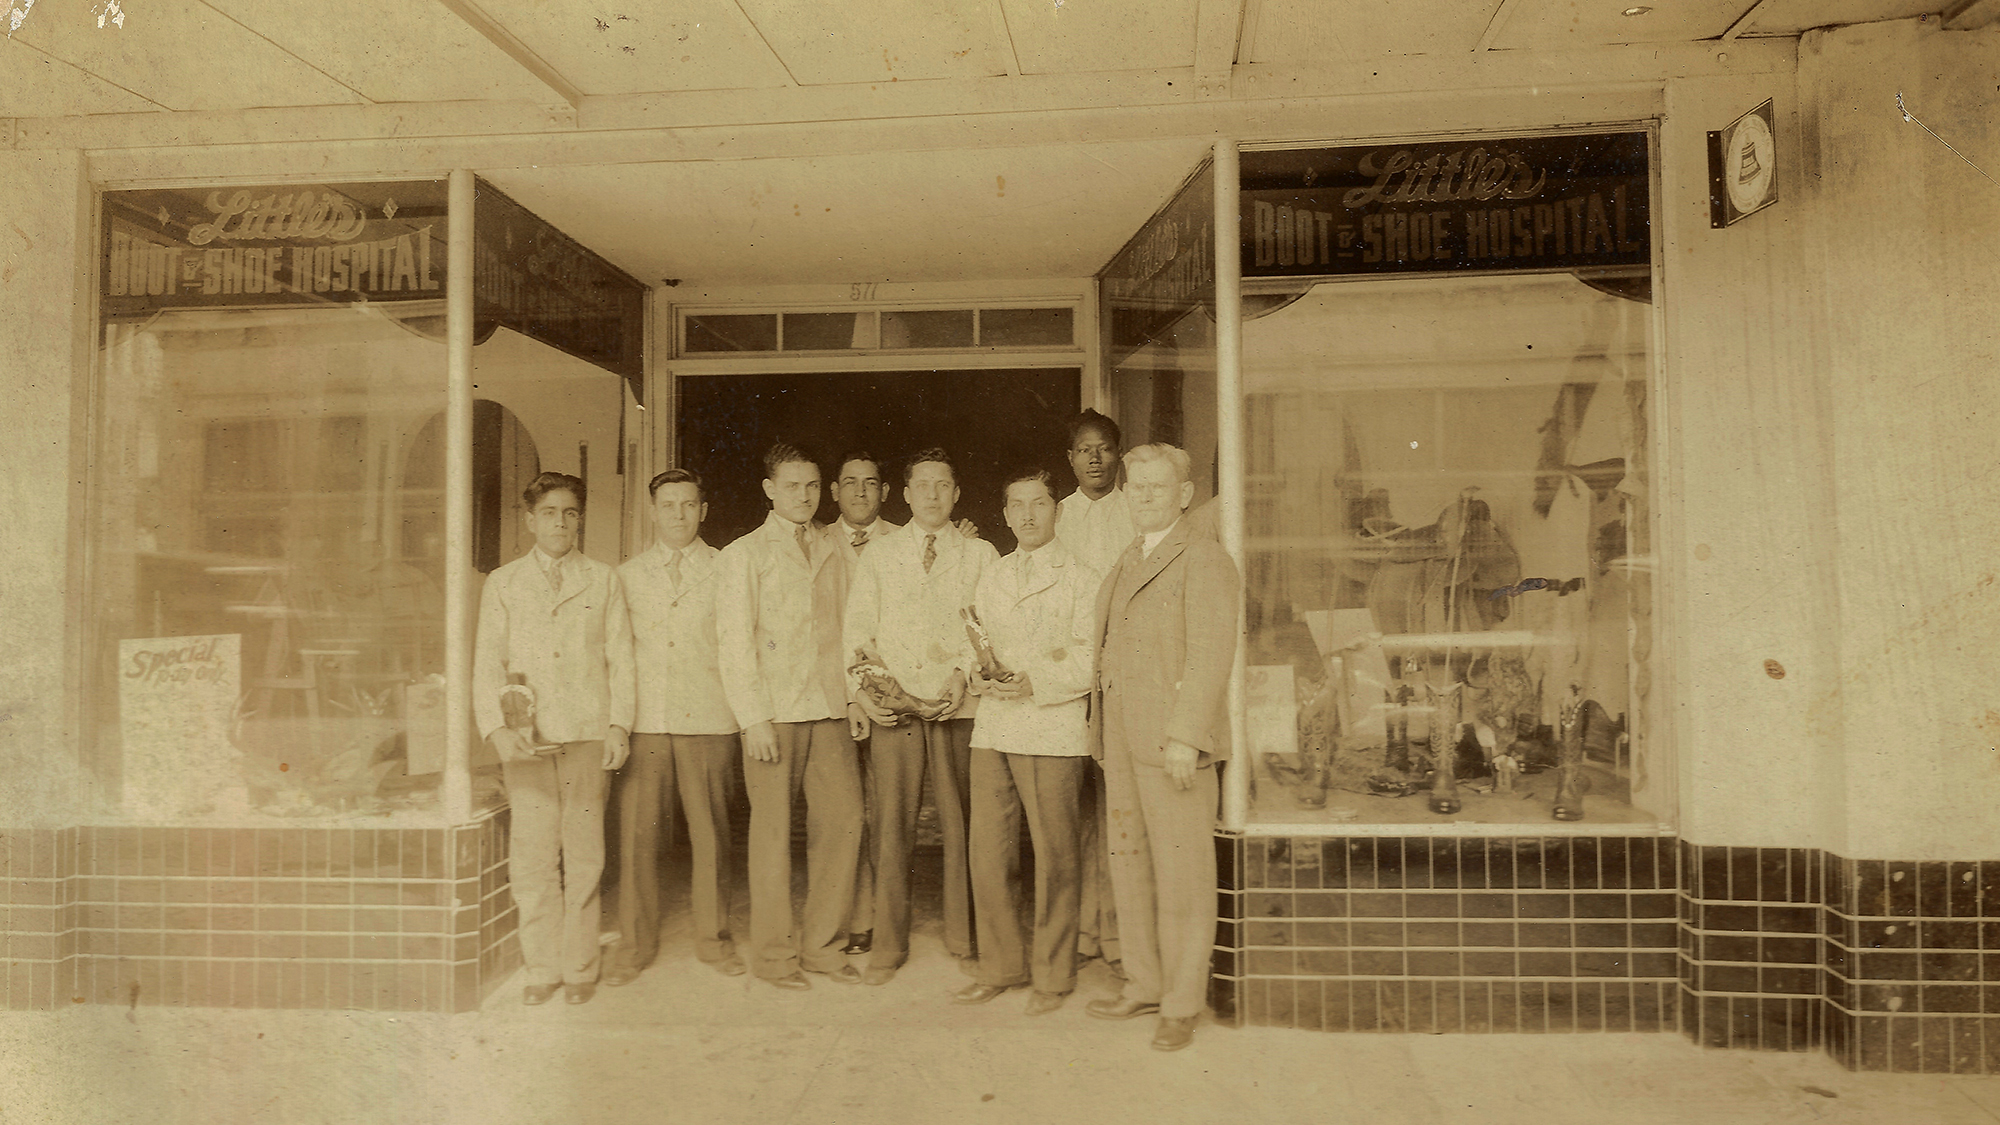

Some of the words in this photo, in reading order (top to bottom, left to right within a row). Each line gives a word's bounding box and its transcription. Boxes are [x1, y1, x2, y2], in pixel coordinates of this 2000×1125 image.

[110, 230, 182, 297] BOOT
[201, 246, 284, 296] SHOE
[292, 225, 439, 293] HOSPITAL
[1255, 200, 1332, 267] BOOT
[1362, 211, 1451, 264] SHOE
[1467, 184, 1641, 259] HOSPITAL
[124, 637, 223, 682] Special
